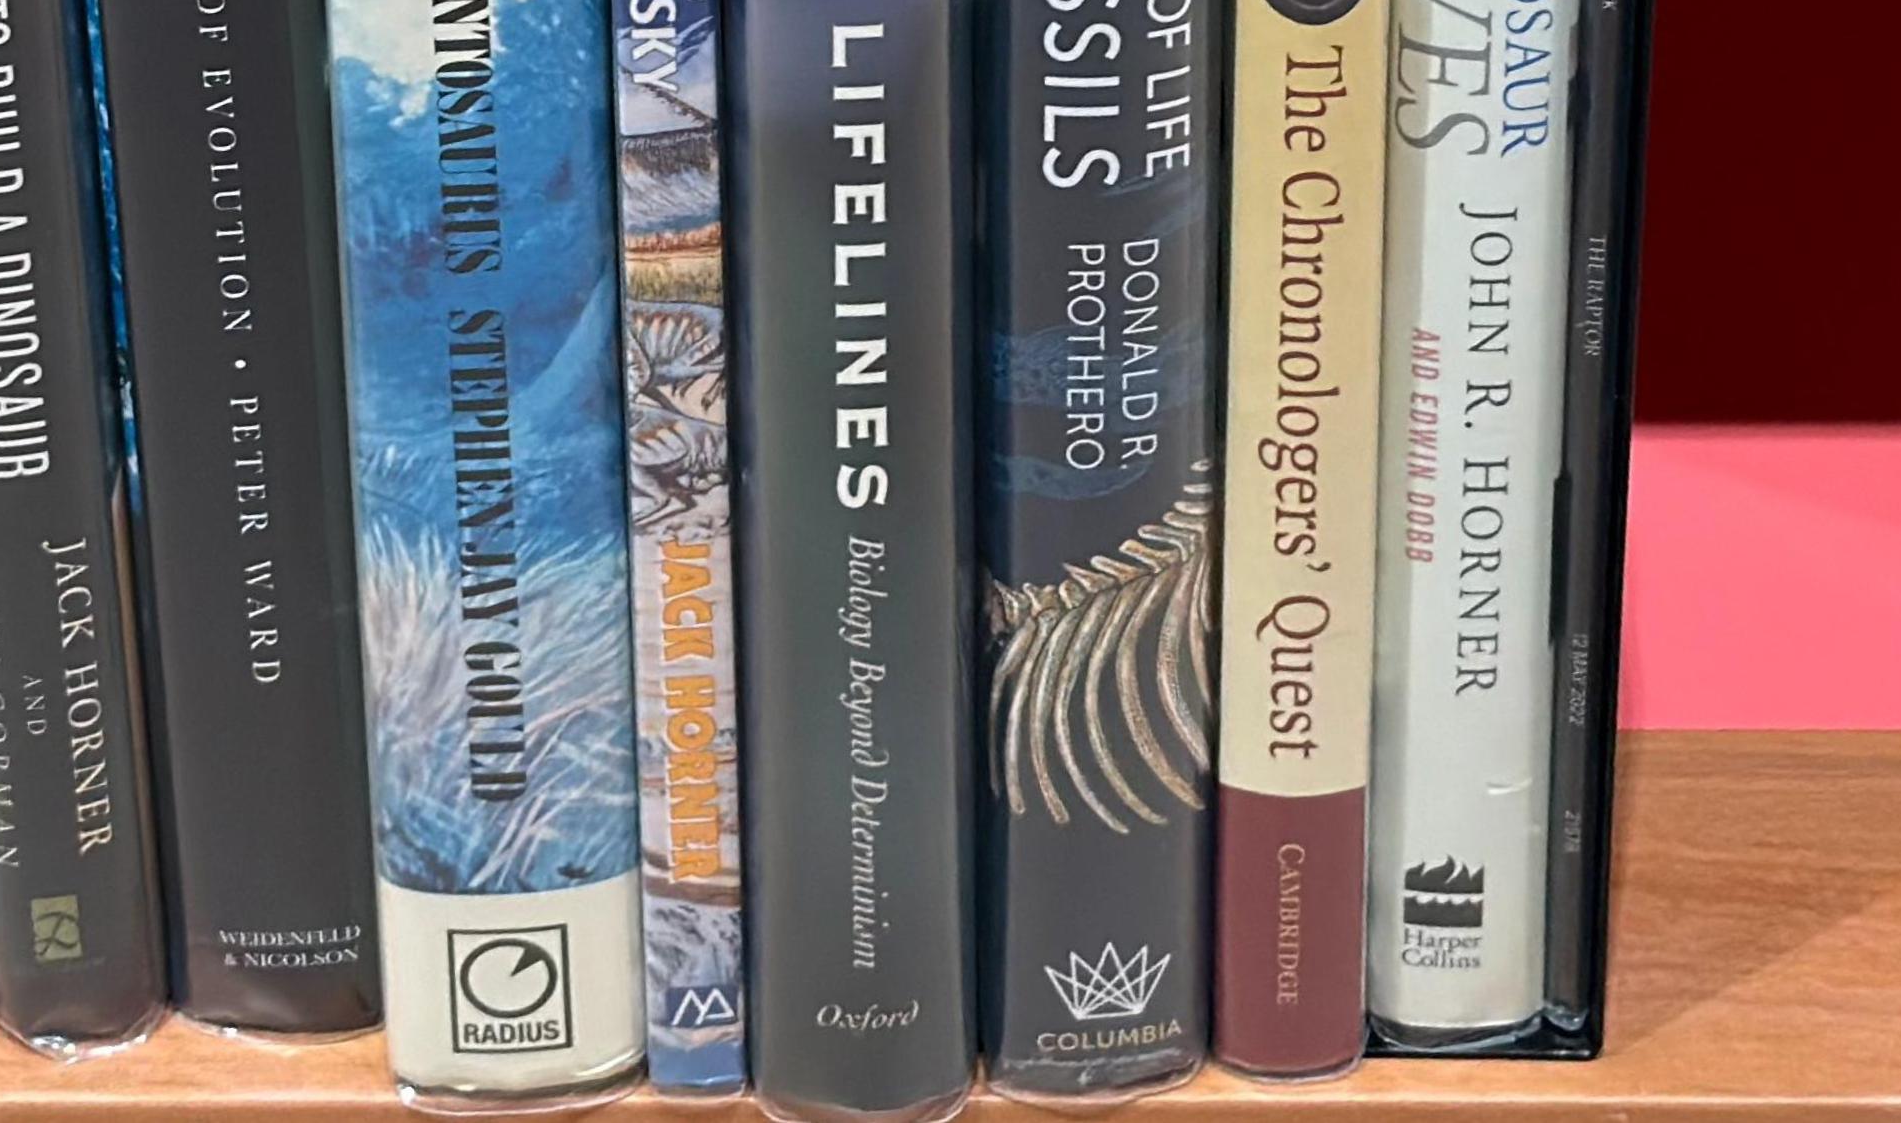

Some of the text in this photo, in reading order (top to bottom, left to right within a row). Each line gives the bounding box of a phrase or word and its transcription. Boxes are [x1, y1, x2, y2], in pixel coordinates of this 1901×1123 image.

[1144, 67, 1191, 179] LIFE
[1283, 44, 1348, 153] The
[203, 68, 253, 335] EVOLUTION
[831, 23, 891, 510] LIFELINES
[1065, 243, 1107, 470] PROTHERO
[1119, 238, 1160, 470] DONALD R.
[1585, 234, 1607, 356] THE RAPTOR
[230, 396, 269, 537] PETER
[447, 308, 516, 533] STEPHEN
[1404, 326, 1441, 564] AND EDWIN DOBB
[1454, 202, 1518, 697] JOHN R. HORNER
[244, 559, 282, 685] WARD
[459, 541, 520, 628] JAY
[22, 674, 48, 737] AND
[41, 537, 113, 856] JACK HORNER
[463, 640, 527, 803] GOULD
[658, 539, 722, 884] JACK HORNER
[837, 535, 890, 969] Biology Beyond Determinism
[1256, 593, 1331, 761] Quest
[1275, 843, 1307, 1006] CAMBRIDGE
[1401, 948, 1481, 969] Collins
[1404, 927, 1483, 953] Harper
[463, 1019, 560, 1046] RADIUS
[816, 998, 920, 1034] Oxford
[1036, 1018, 1183, 1052] COLUMBIA
